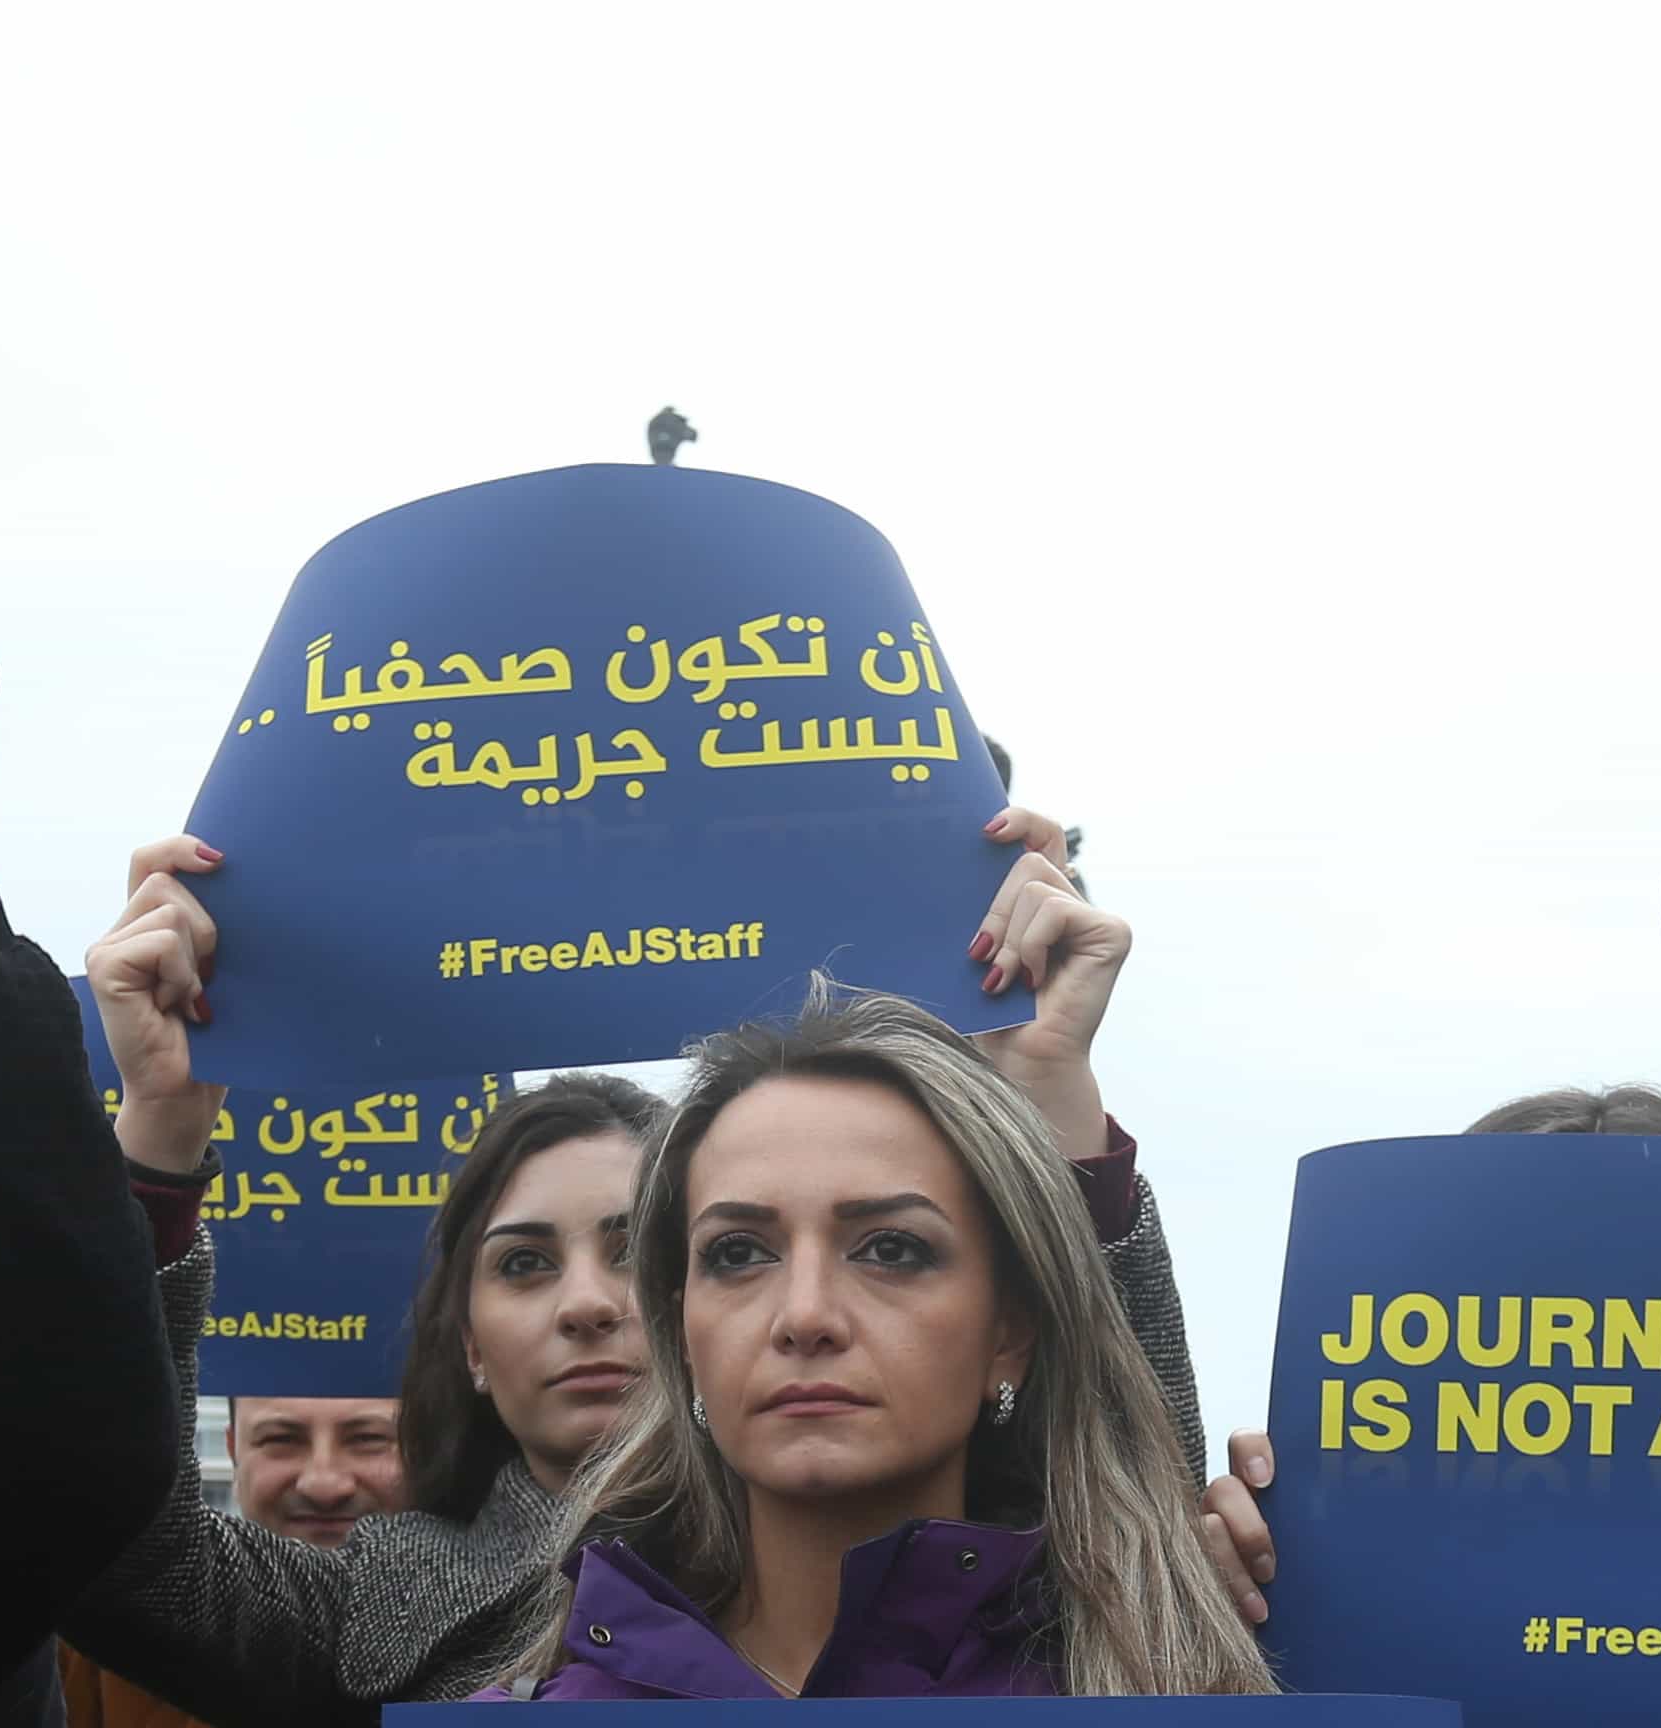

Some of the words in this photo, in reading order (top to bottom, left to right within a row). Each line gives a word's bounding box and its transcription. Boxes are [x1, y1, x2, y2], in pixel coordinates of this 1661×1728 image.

[606, 615, 827, 702] تكون
[861, 624, 942, 695] أن
[407, 722, 667, 805] جريمة
[701, 702, 958, 781] ليست
[441, 922, 763, 976] #FreeAJStaff
[259, 1094, 419, 1171] تكون
[1321, 1380, 1411, 1451] IS
[1437, 1382, 1634, 1455] NOT
